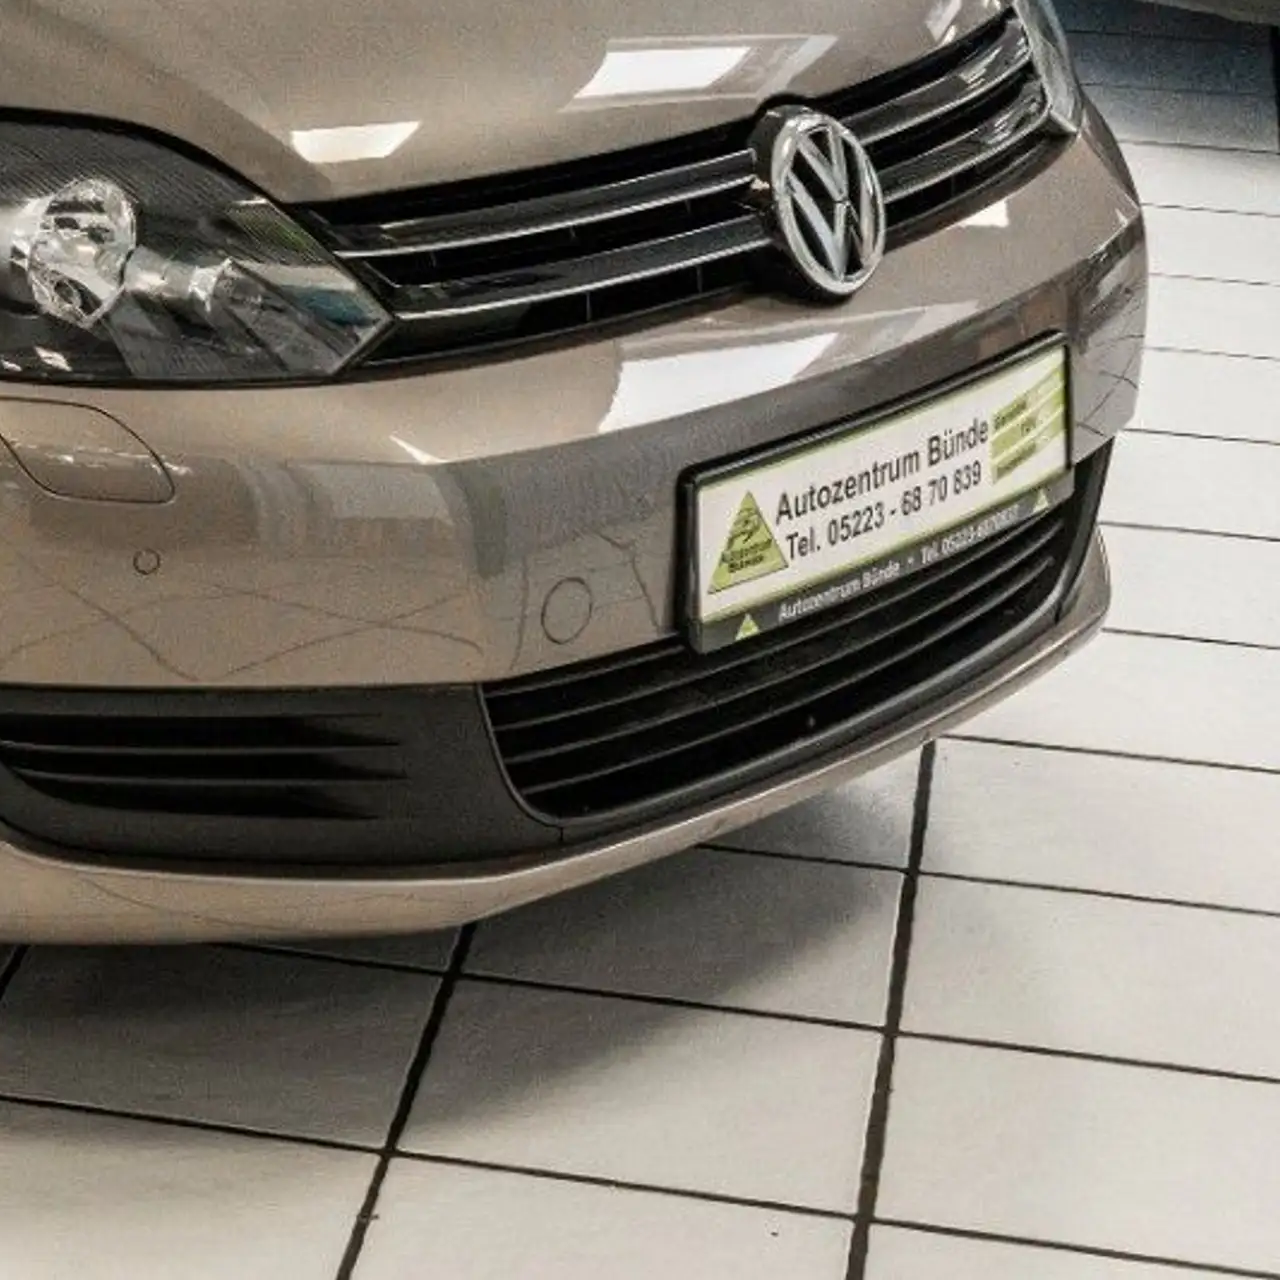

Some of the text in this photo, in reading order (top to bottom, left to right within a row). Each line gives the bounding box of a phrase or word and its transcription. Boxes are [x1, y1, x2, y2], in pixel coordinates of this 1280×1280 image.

[775, 450, 920, 525] Autozentrum
[927, 417, 989, 468] Bünde
[786, 527, 821, 561] Tel.
[827, 501, 885, 546] 05223
[901, 485, 922, 516] 68
[928, 475, 948, 506] 70
[953, 459, 982, 495] 839
